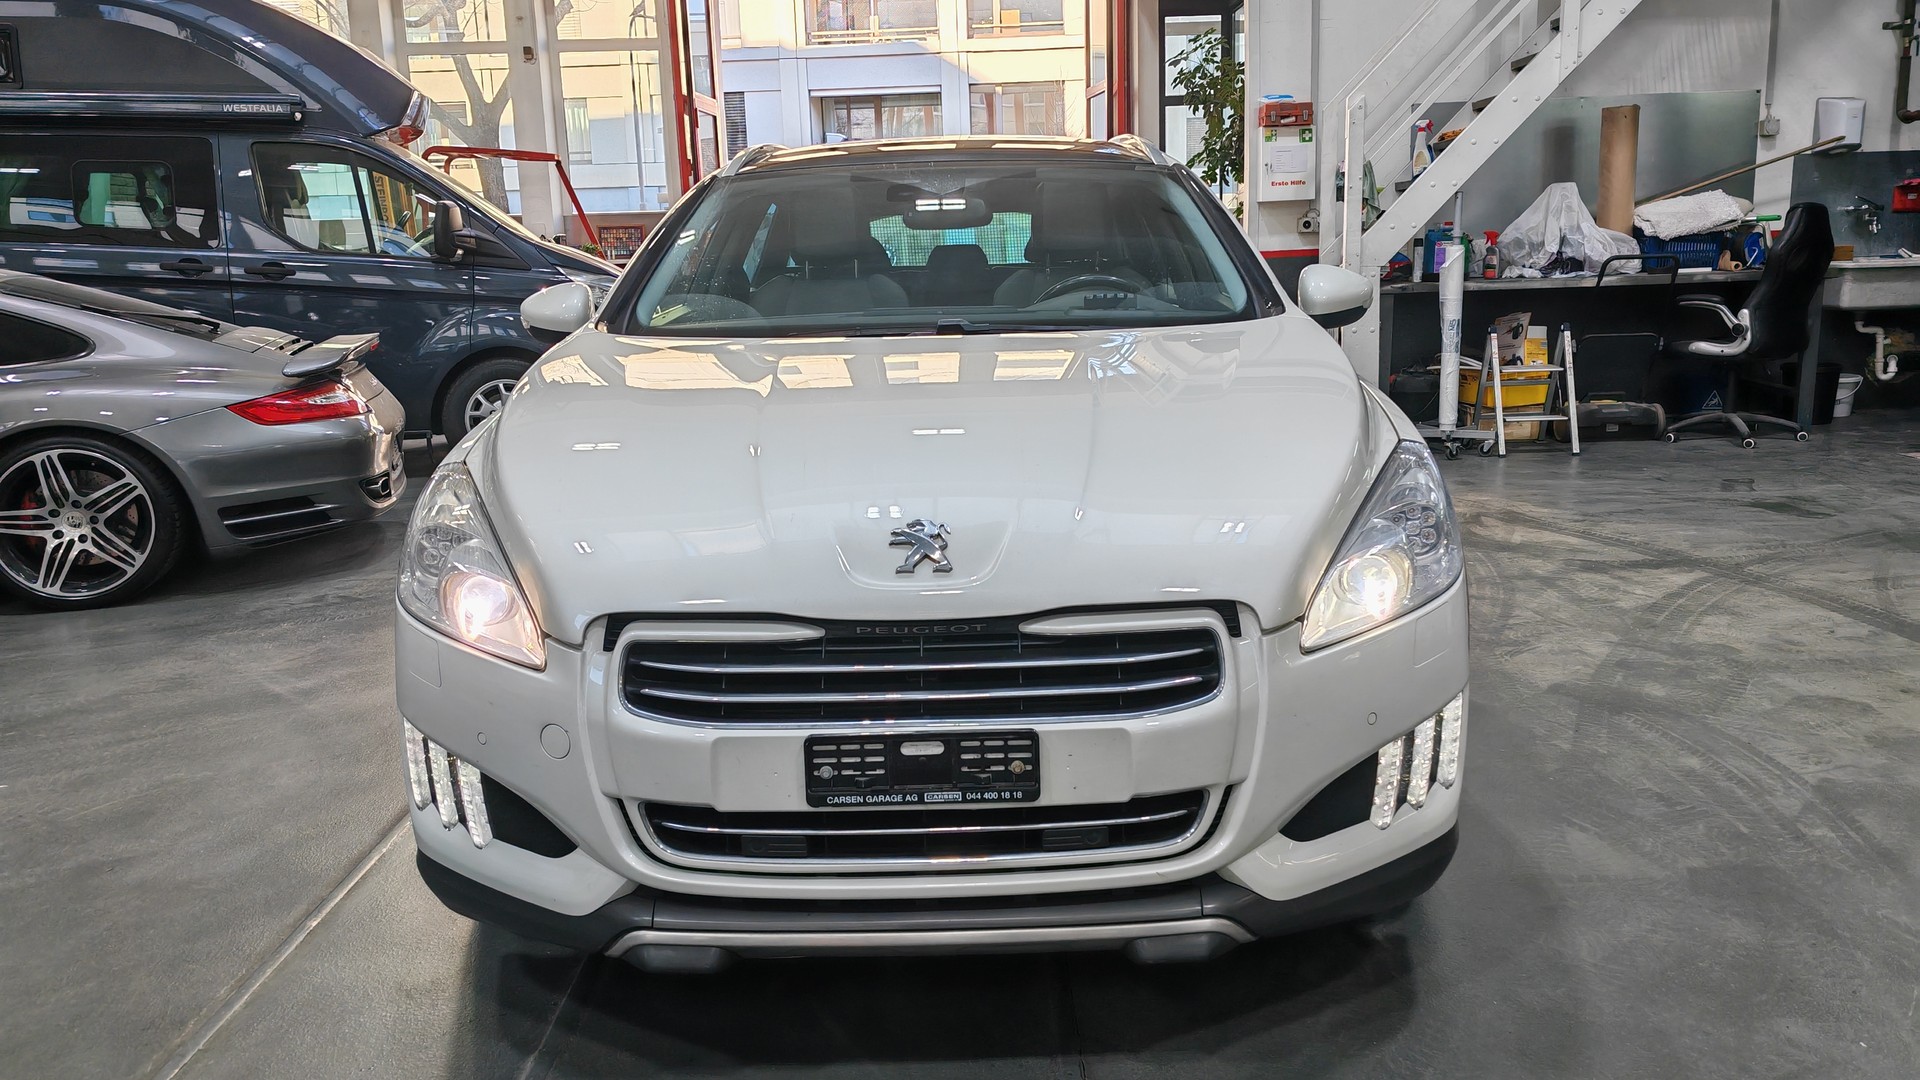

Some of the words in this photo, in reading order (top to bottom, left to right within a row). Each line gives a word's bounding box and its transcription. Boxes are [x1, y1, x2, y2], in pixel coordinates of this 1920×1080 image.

[222, 104, 283, 112] WESTFALIA
[856, 624, 987, 634] PEUGEOT
[826, 795, 864, 804] CARSEN
[865, 794, 903, 803] GARAGE
[904, 794, 918, 802] AG
[966, 792, 981, 800] 044
[983, 791, 998, 800] 400
[1000, 791, 1011, 799] 18
[1012, 790, 1023, 799] 18
